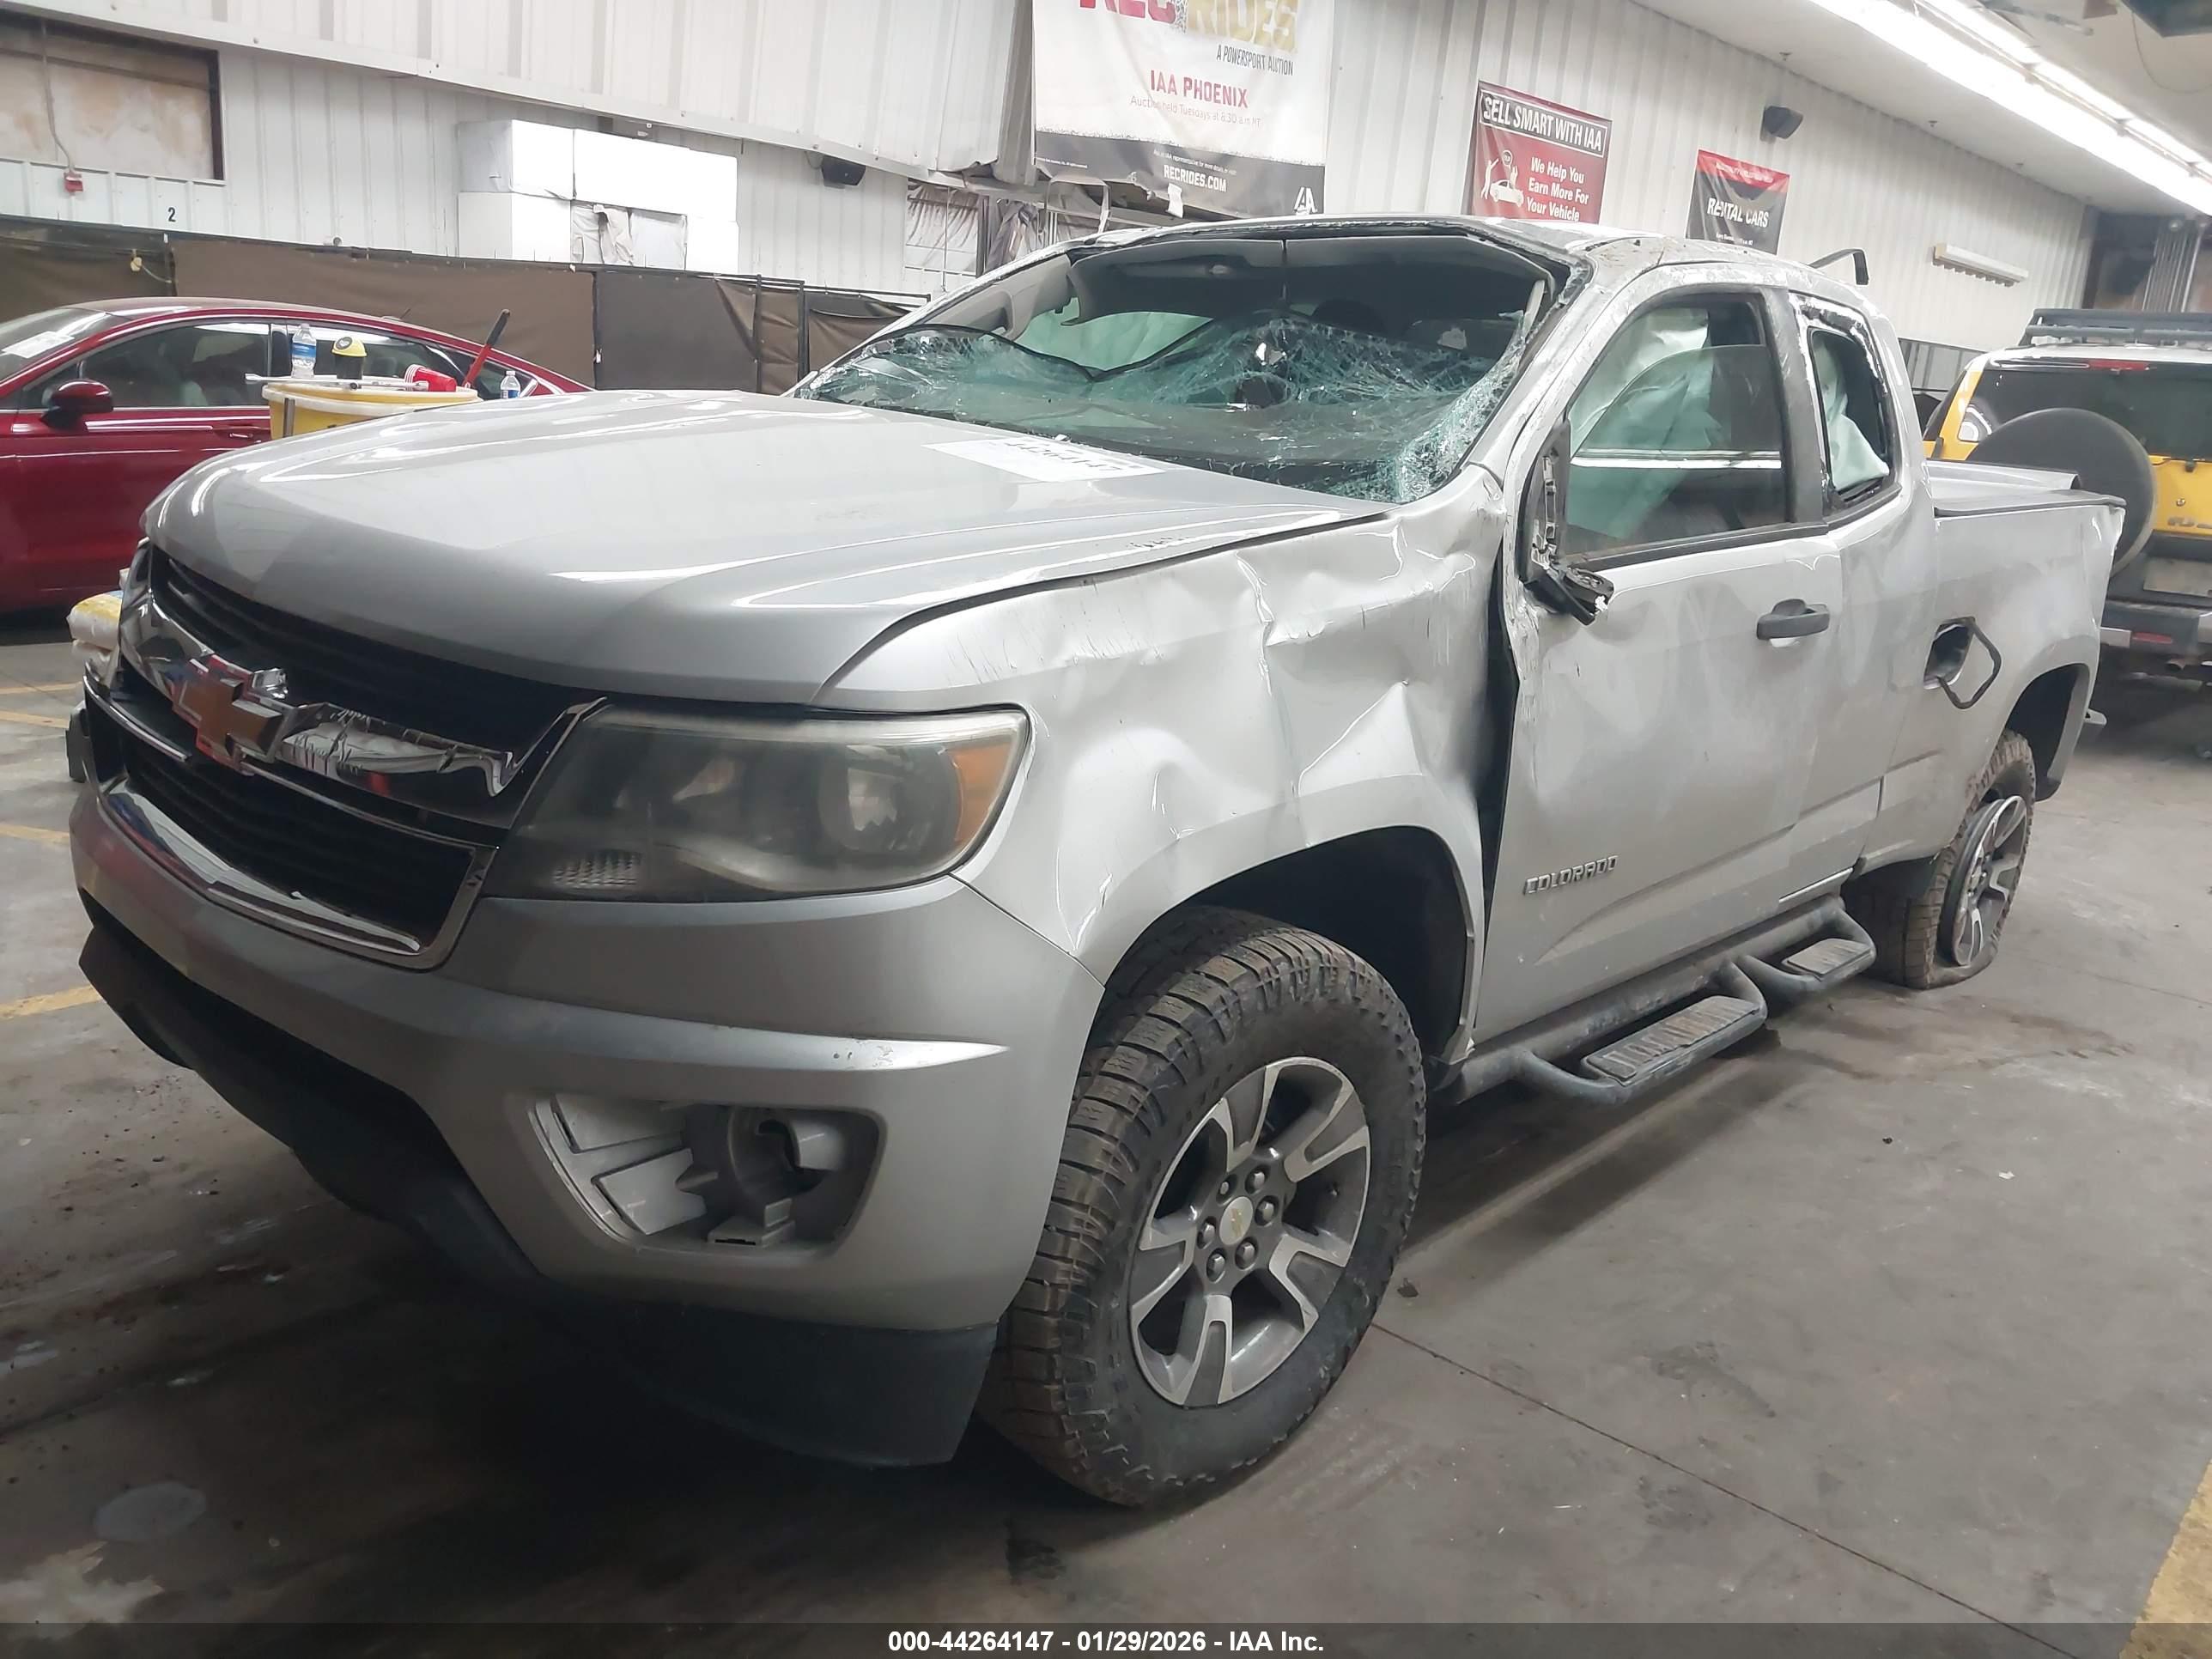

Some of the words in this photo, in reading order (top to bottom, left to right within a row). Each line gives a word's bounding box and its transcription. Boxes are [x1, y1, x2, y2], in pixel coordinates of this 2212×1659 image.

[1216, 44, 1222, 61] A
[1223, 46, 1266, 70] POWERSPORT
[1267, 56, 1294, 76] AUCTION
[1151, 70, 1177, 96] IAA
[1183, 76, 1248, 108] PHOENIX
[1179, 103, 1210, 121] Tuesdays
[1483, 96, 1511, 125] SELL
[1513, 106, 1554, 137] SMART
[1555, 118, 1583, 146] WITH
[1583, 127, 1602, 152] IAA
[1164, 164, 1227, 192] RECRIDES.COM
[1531, 157, 1545, 173] We
[1547, 161, 1567, 183] Help
[1570, 167, 1585, 184] You
[1528, 177, 1548, 195] Earn
[1551, 182, 1573, 201] More
[1575, 189, 1589, 205] For
[168, 207, 176, 222] 2
[1527, 197, 1547, 215] Your
[1549, 201, 1579, 222] Vehicle
[1707, 198, 1743, 222] RENTAL
[1746, 210, 1769, 228] CARS
[1524, 855, 1619, 894] COLORADO
